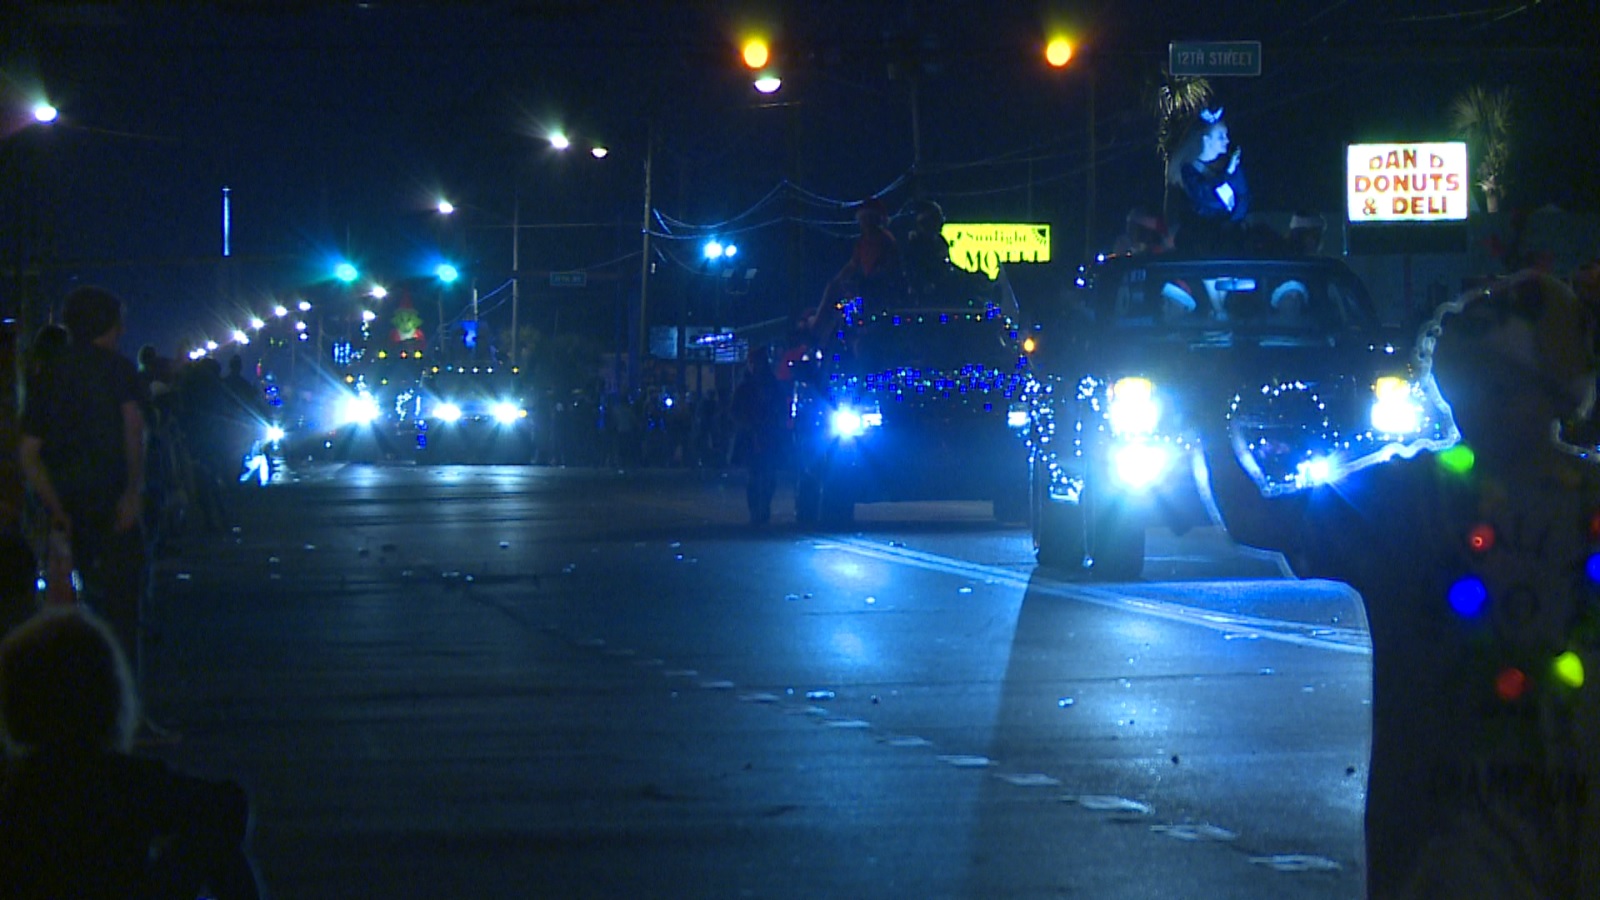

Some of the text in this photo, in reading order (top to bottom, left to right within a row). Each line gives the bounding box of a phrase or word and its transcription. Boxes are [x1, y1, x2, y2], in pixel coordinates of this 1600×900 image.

[1177, 50, 1253, 67] 12TH STREET
[1369, 150, 1444, 169] DAN D
[1355, 173, 1460, 192] DONUTS
[1363, 197, 1447, 215] & DELI
